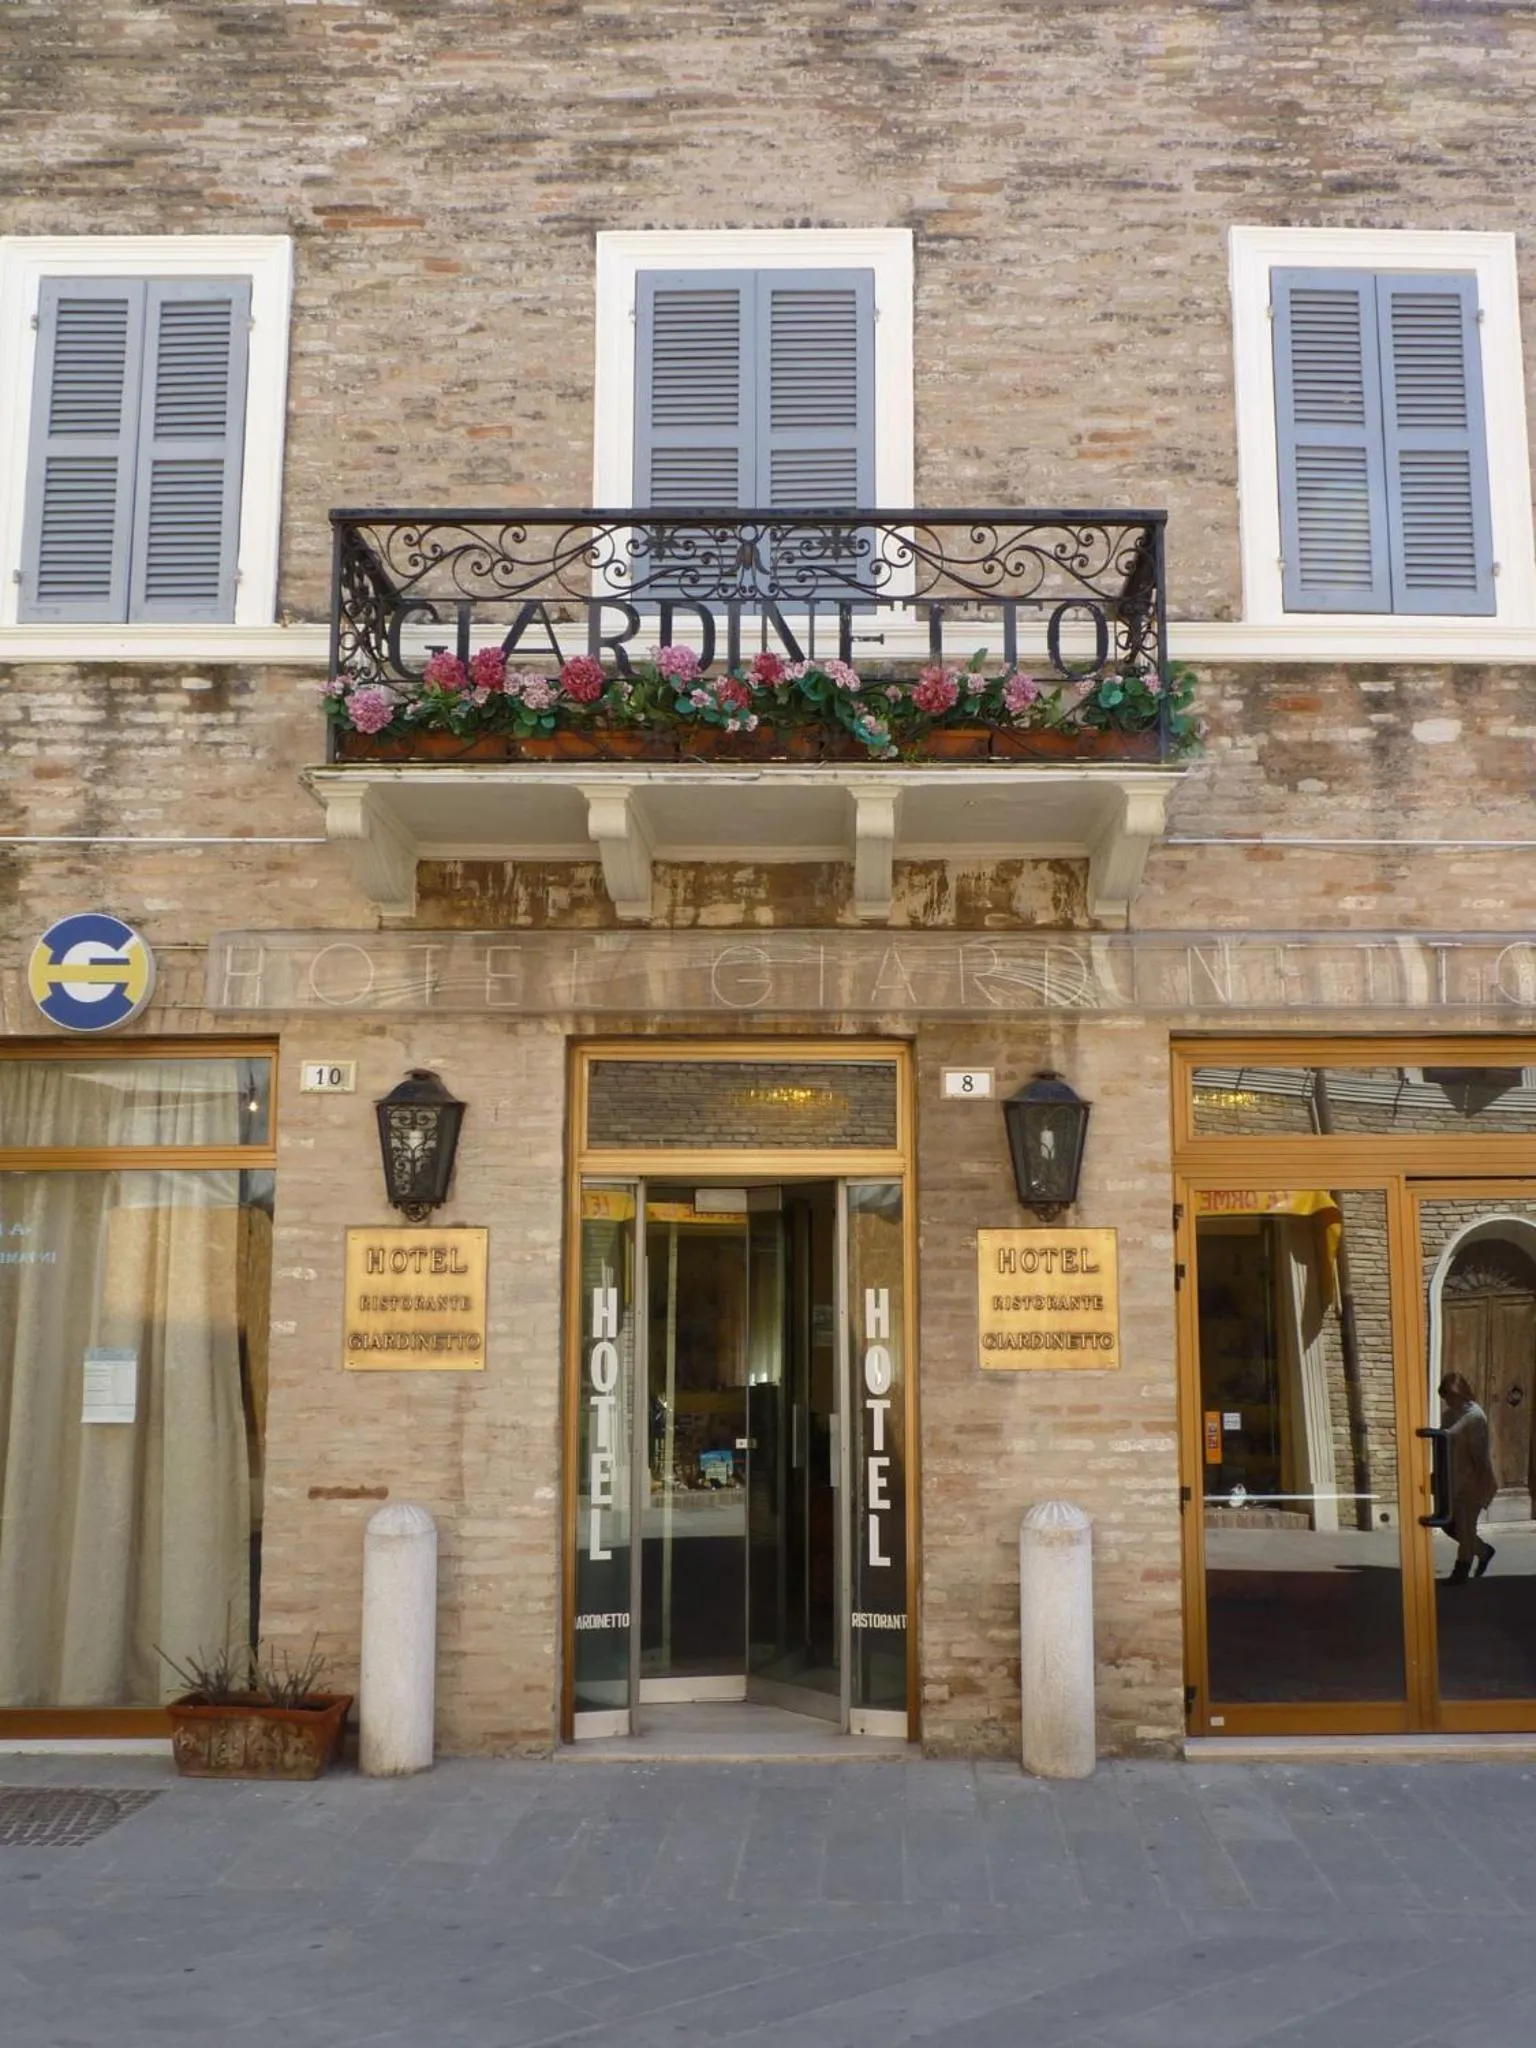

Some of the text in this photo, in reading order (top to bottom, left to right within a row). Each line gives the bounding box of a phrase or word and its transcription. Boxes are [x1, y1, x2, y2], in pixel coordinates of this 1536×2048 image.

[387, 600, 1108, 680] GIARDINETTO
[223, 943, 603, 1007] HOTEL
[316, 1067, 341, 1085] 10
[962, 1075, 973, 1092] 8
[366, 1247, 468, 1274] HOTEL
[998, 1247, 1100, 1274] HOTEL
[360, 1294, 472, 1312] RISTORANTE
[992, 1294, 1104, 1311] RISTORANTE
[348, 1331, 482, 1353] GIARDINETTO
[982, 1331, 1115, 1351] GIARDINETTO
[590, 1287, 618, 1560] HOTEL
[864, 1288, 892, 1566] HOTEL
[574, 1612, 630, 1630] ARDINETTO
[851, 1612, 908, 1630] RISTORANT
